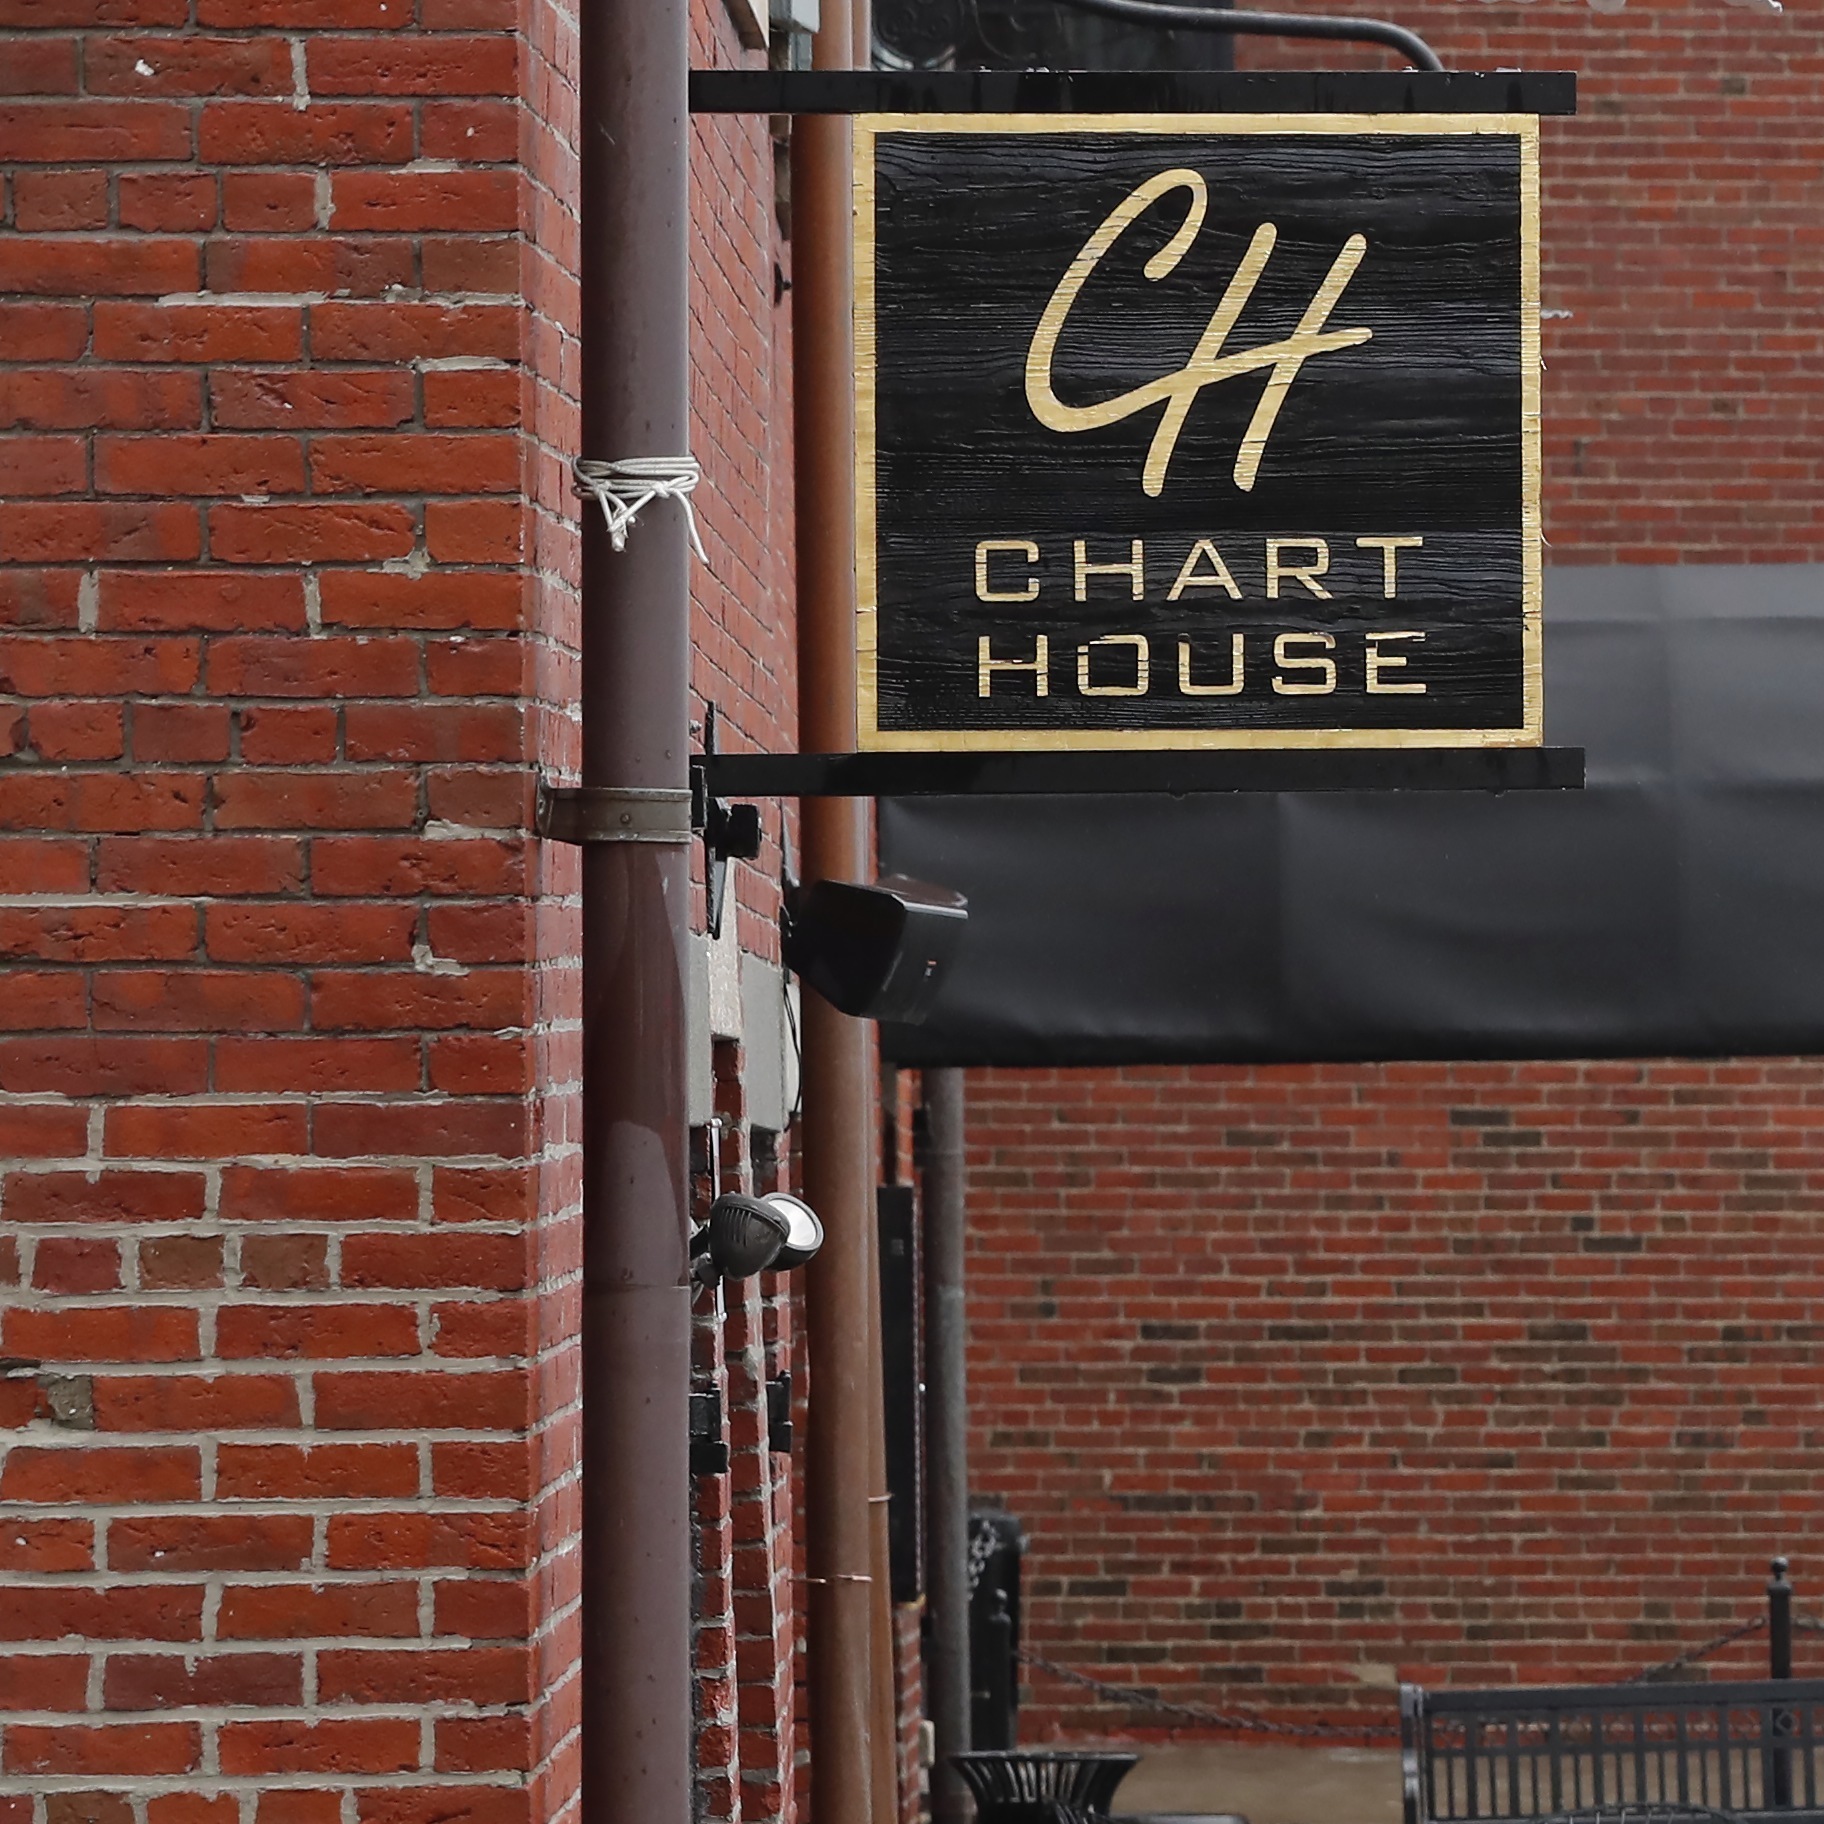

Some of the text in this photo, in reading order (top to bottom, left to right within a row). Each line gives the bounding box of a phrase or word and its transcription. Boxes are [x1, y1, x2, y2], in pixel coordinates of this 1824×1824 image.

[1025, 168, 1373, 498] CH
[973, 535, 1424, 603] CHART
[977, 631, 1427, 698] HOUSE
